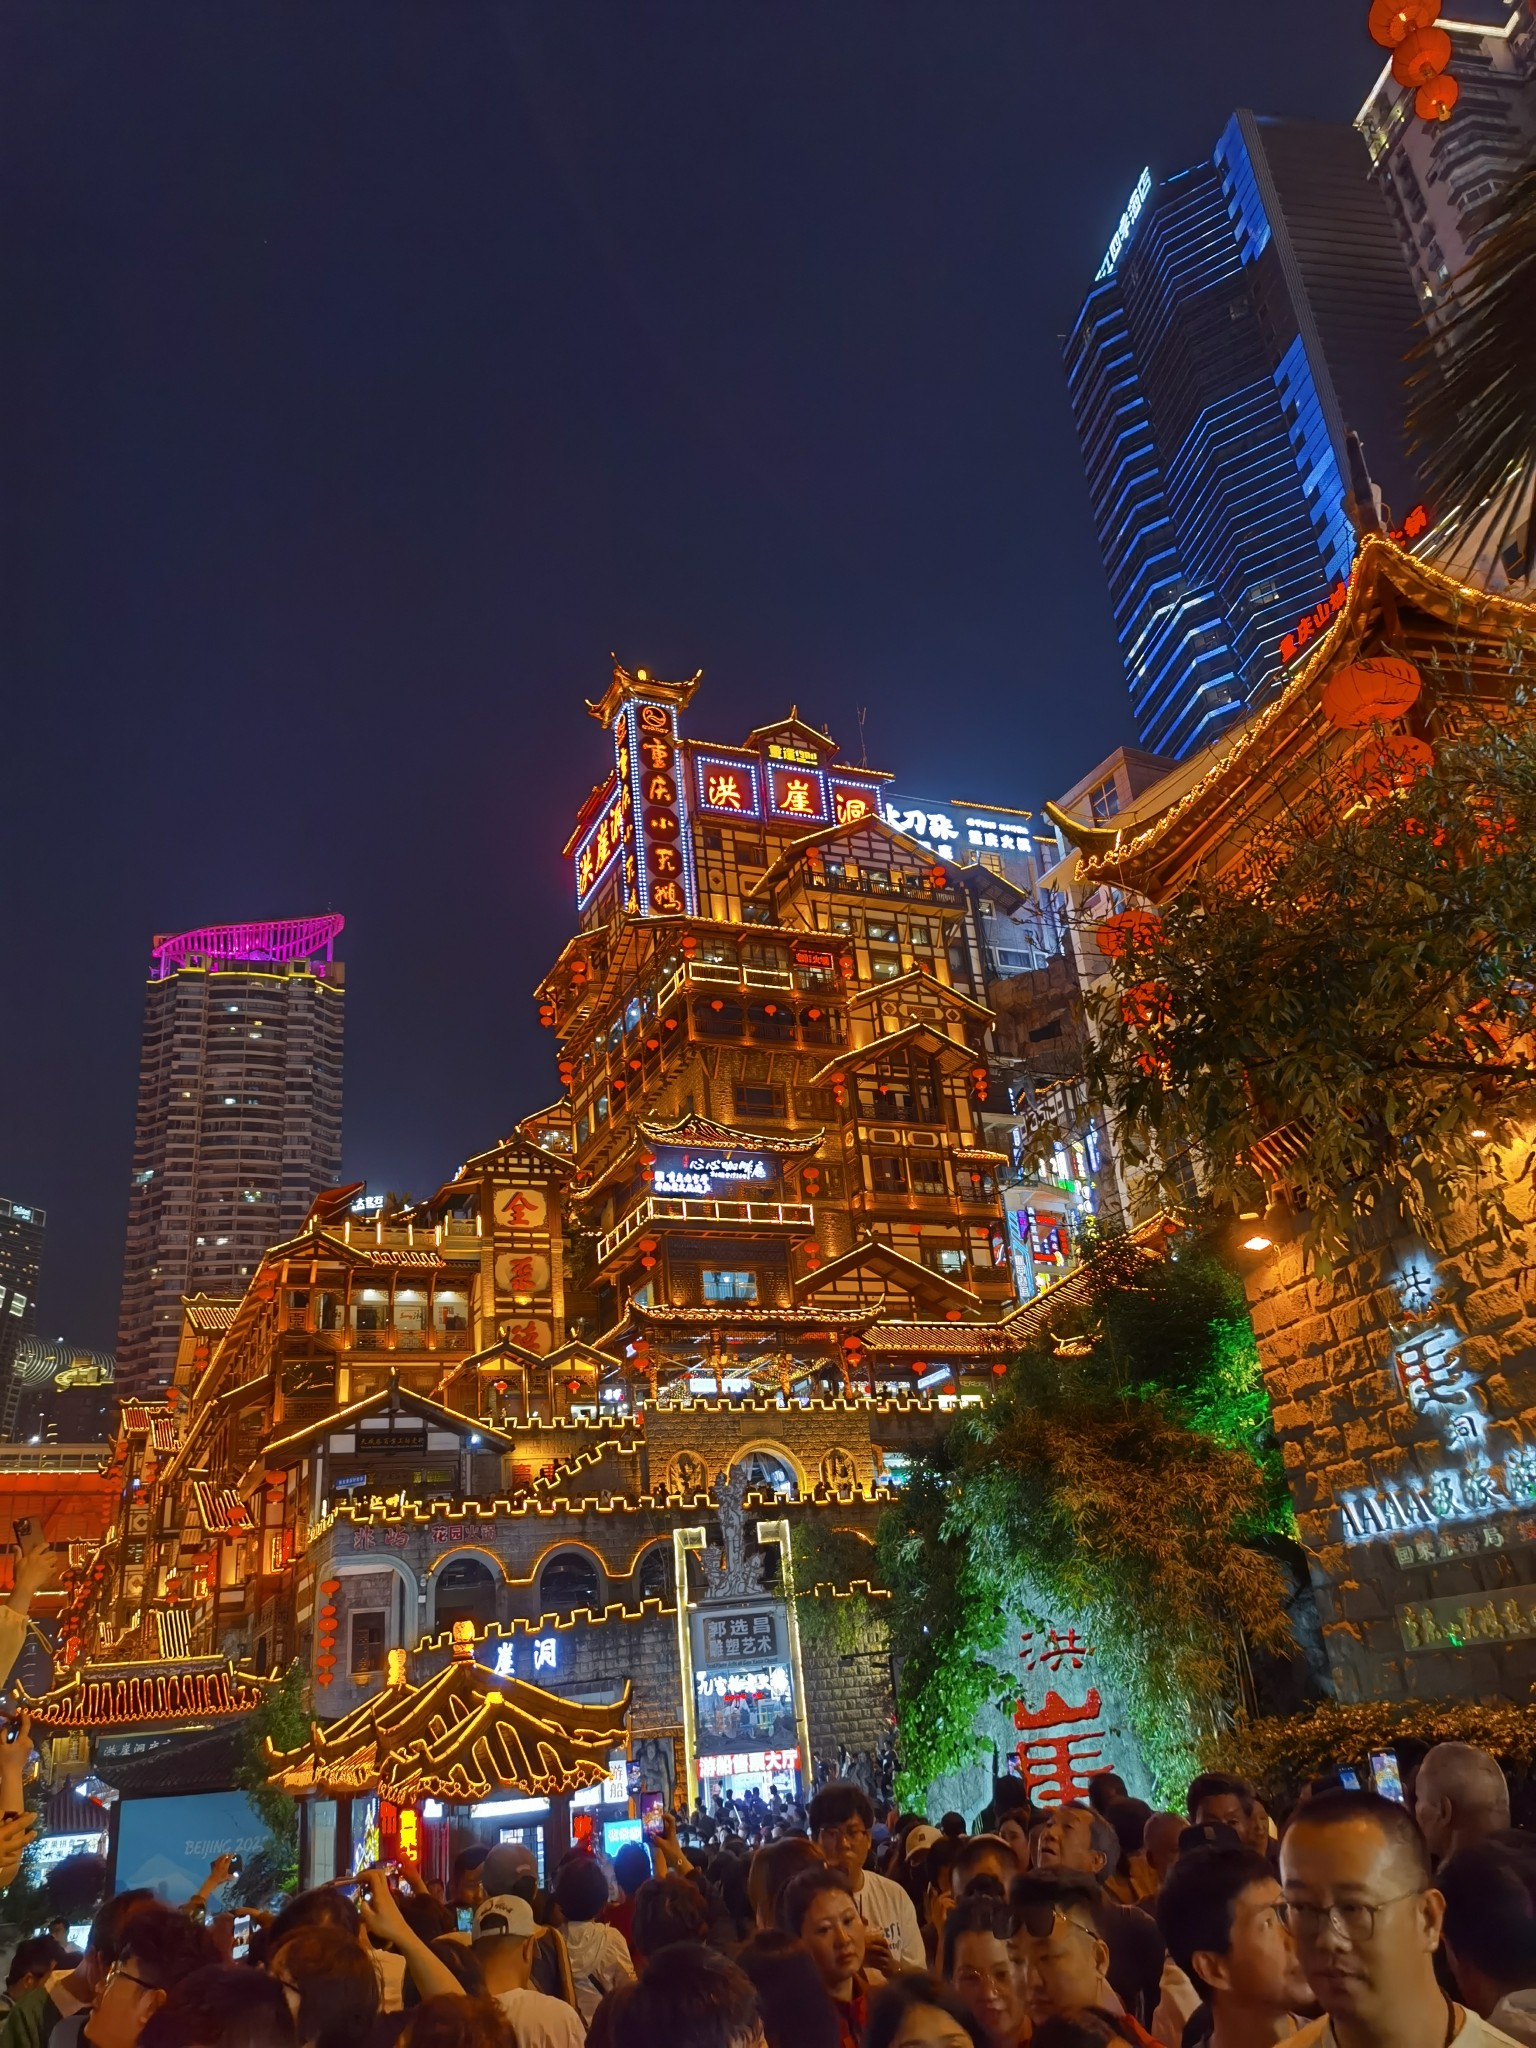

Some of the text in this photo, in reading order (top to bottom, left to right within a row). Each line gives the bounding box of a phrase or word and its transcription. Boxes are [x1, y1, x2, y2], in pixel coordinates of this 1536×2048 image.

[708, 775, 866, 823] 洪崖洞
[708, 1616, 771, 1637] 郭选昌
[709, 1635, 772, 1658] 雕塑艺术
[699, 1749, 798, 1779] 游船售票大厅
